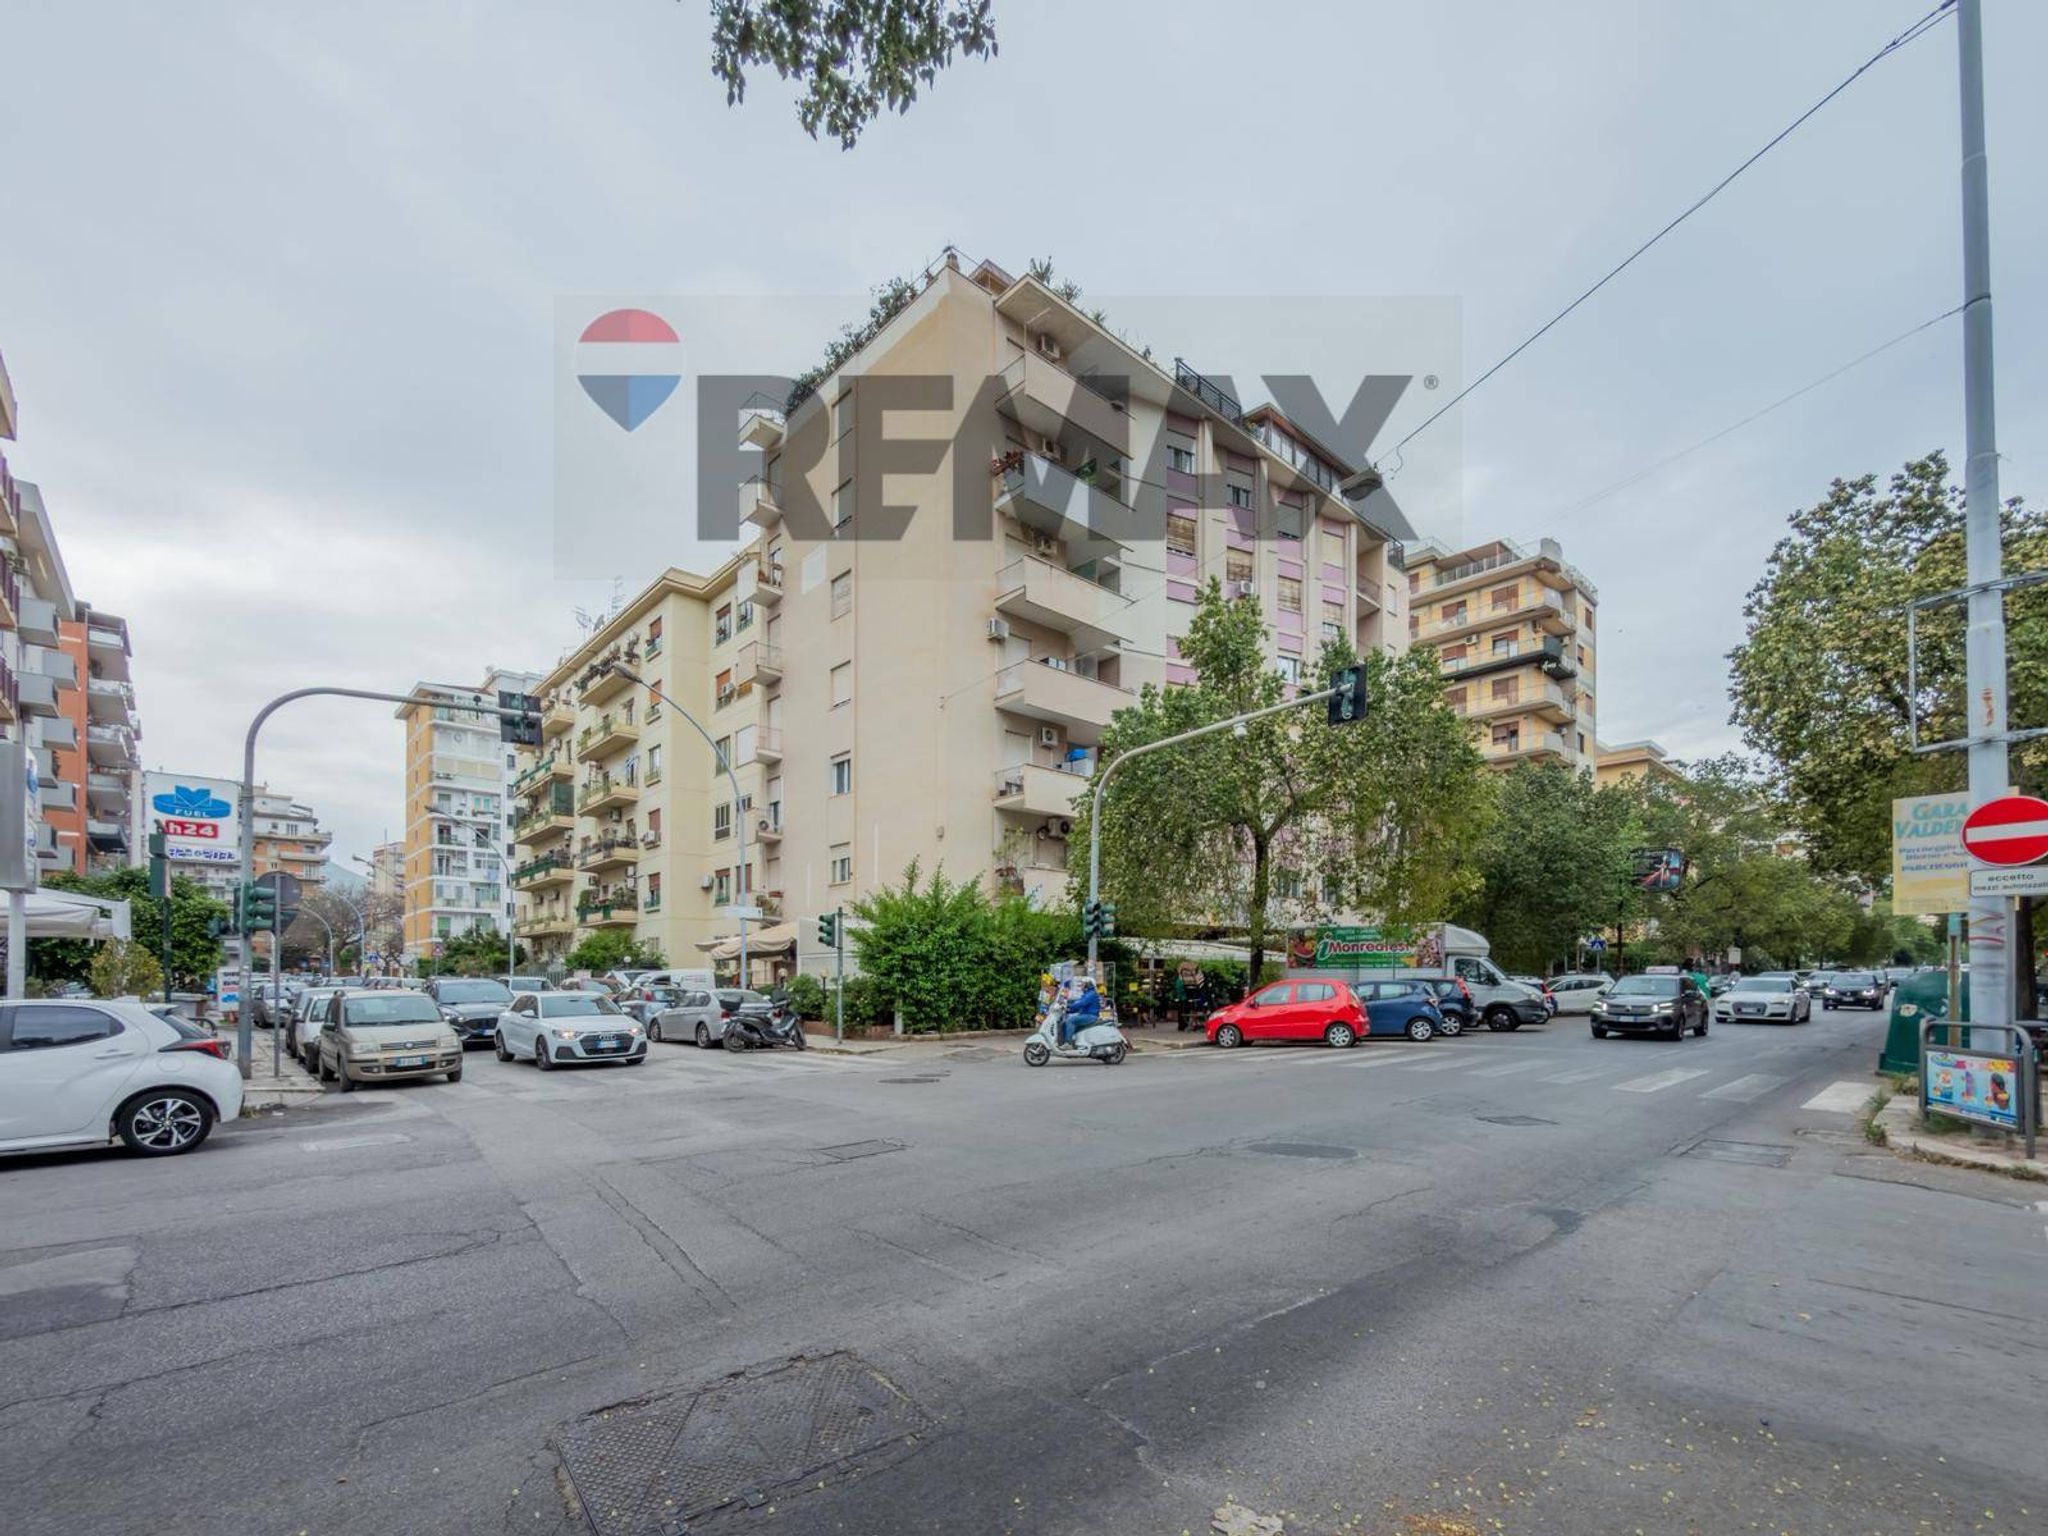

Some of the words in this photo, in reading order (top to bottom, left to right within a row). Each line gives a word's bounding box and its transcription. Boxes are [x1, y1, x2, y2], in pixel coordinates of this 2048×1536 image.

[175, 808, 210, 818] FUEL
[1912, 803, 1969, 821] GARA
[168, 822, 215, 837] h24
[1895, 819, 1961, 839] VALDE
